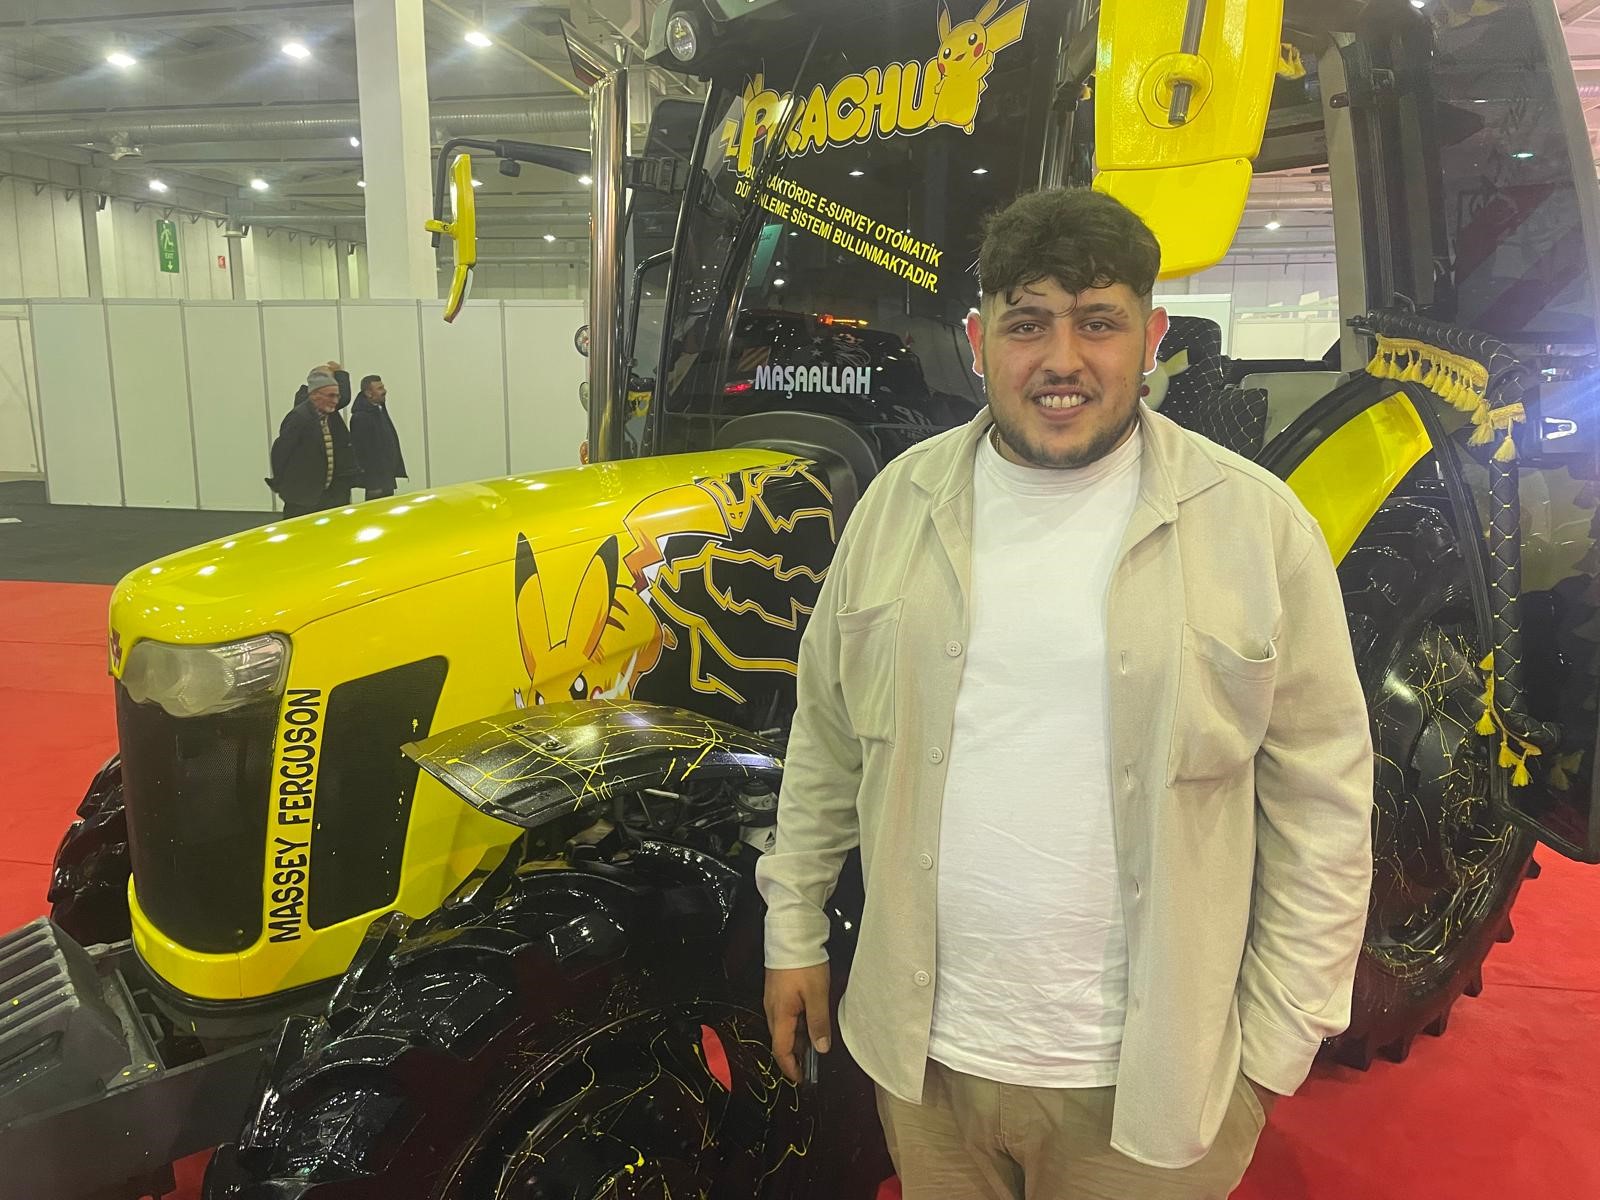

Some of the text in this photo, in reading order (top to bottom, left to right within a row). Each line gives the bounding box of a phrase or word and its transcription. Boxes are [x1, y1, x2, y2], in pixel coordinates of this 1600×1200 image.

[734, 180, 938, 293] DÜNLEME SİSTEMİ BULUNMAKTADIR.
[766, 173, 818, 209] AKTÖRDE
[816, 196, 876, 235] E-SURVEY
[875, 223, 944, 268] OTOMATİK
[754, 364, 872, 400] MAŞAALLAH
[268, 688, 322, 944] MASSEY FERGUSON
